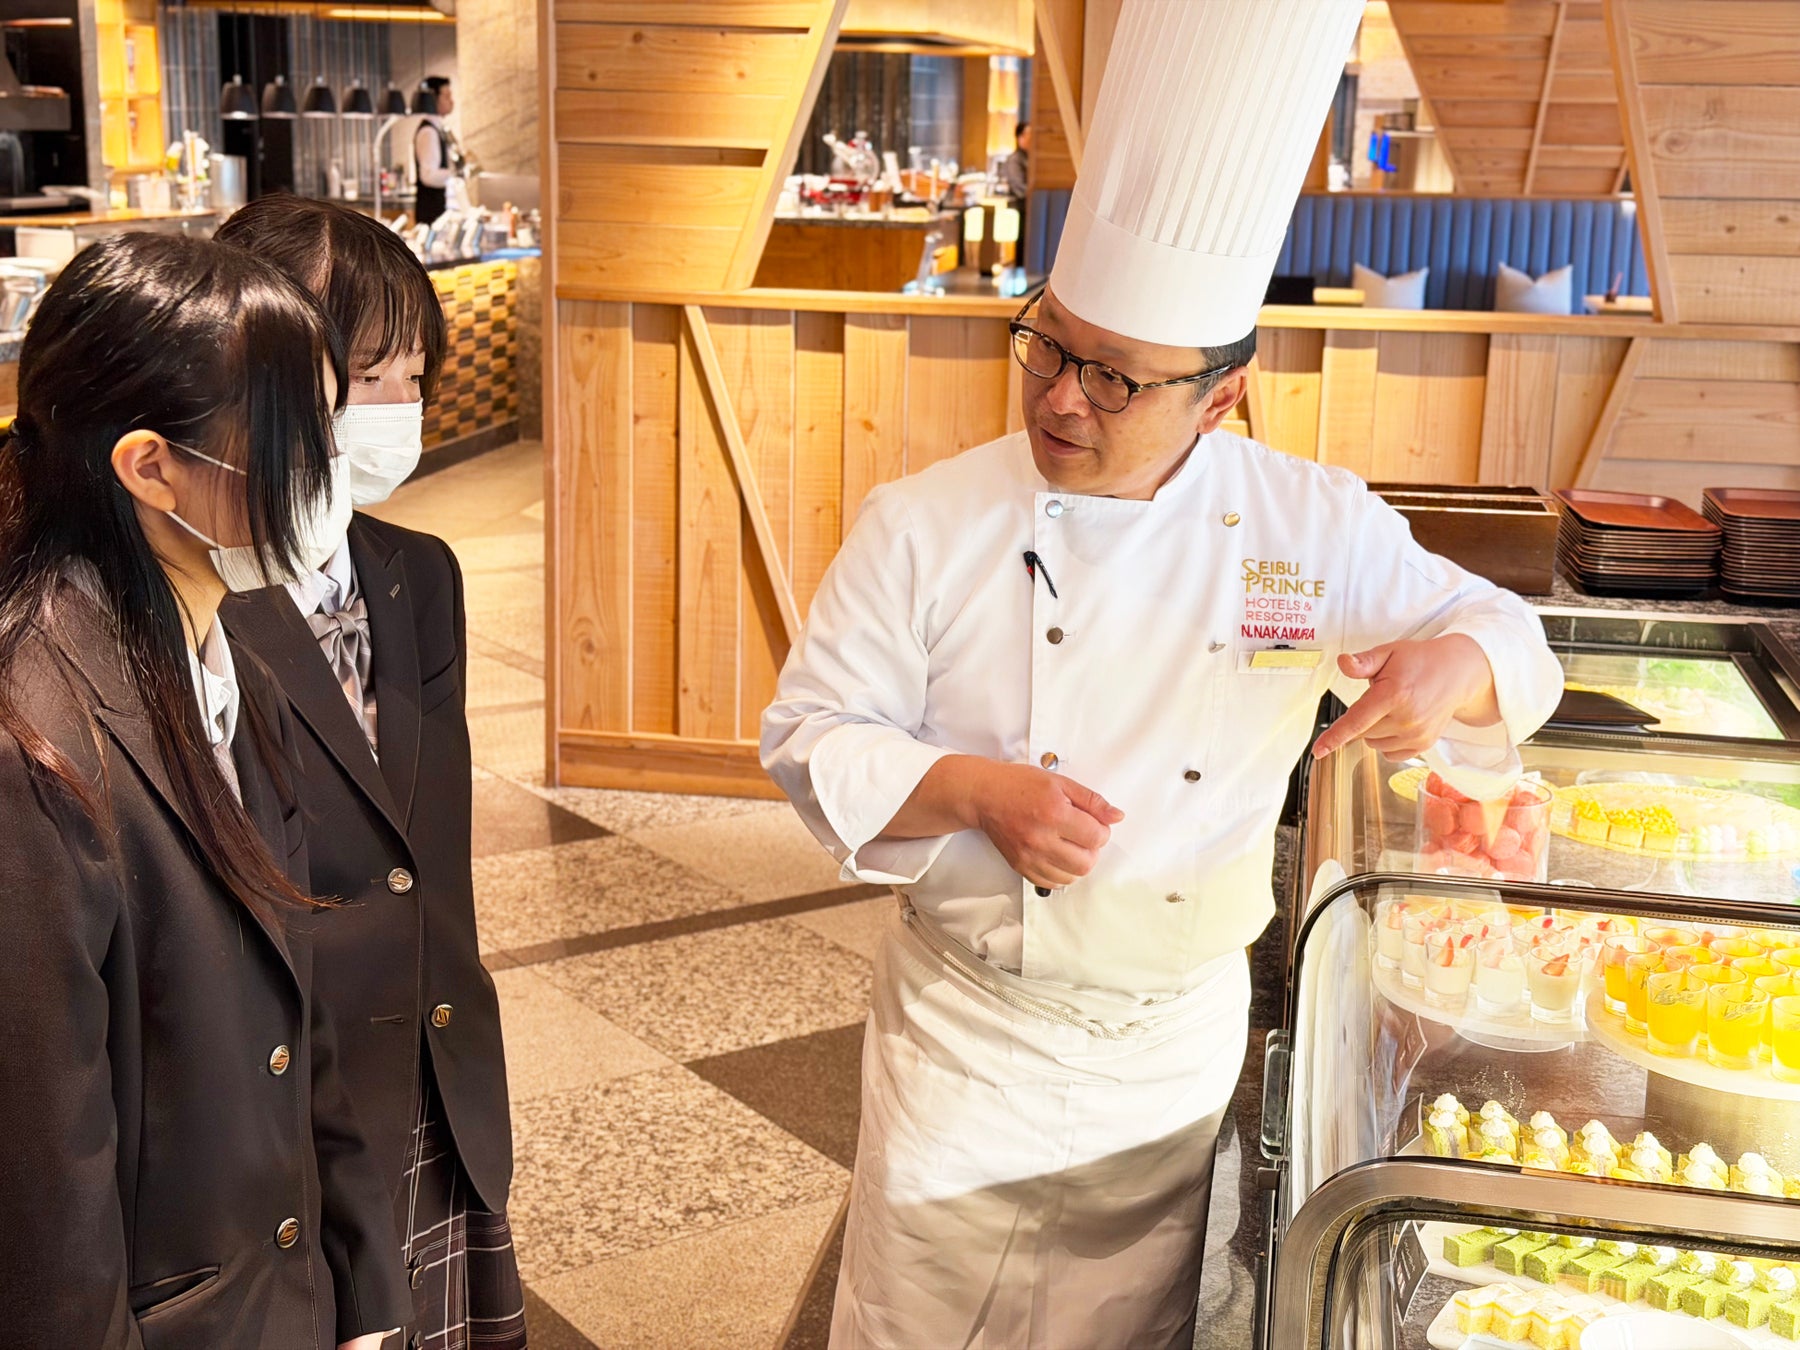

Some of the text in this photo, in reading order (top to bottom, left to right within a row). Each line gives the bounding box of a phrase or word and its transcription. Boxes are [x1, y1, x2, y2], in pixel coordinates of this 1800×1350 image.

[1241, 559, 1300, 578] SEIBU
[1242, 572, 1325, 597] PRINCE
[1246, 598, 1312, 611] HOTELS &
[1246, 611, 1307, 624] RESORTS
[1241, 624, 1315, 640] N.NAKAMURA
